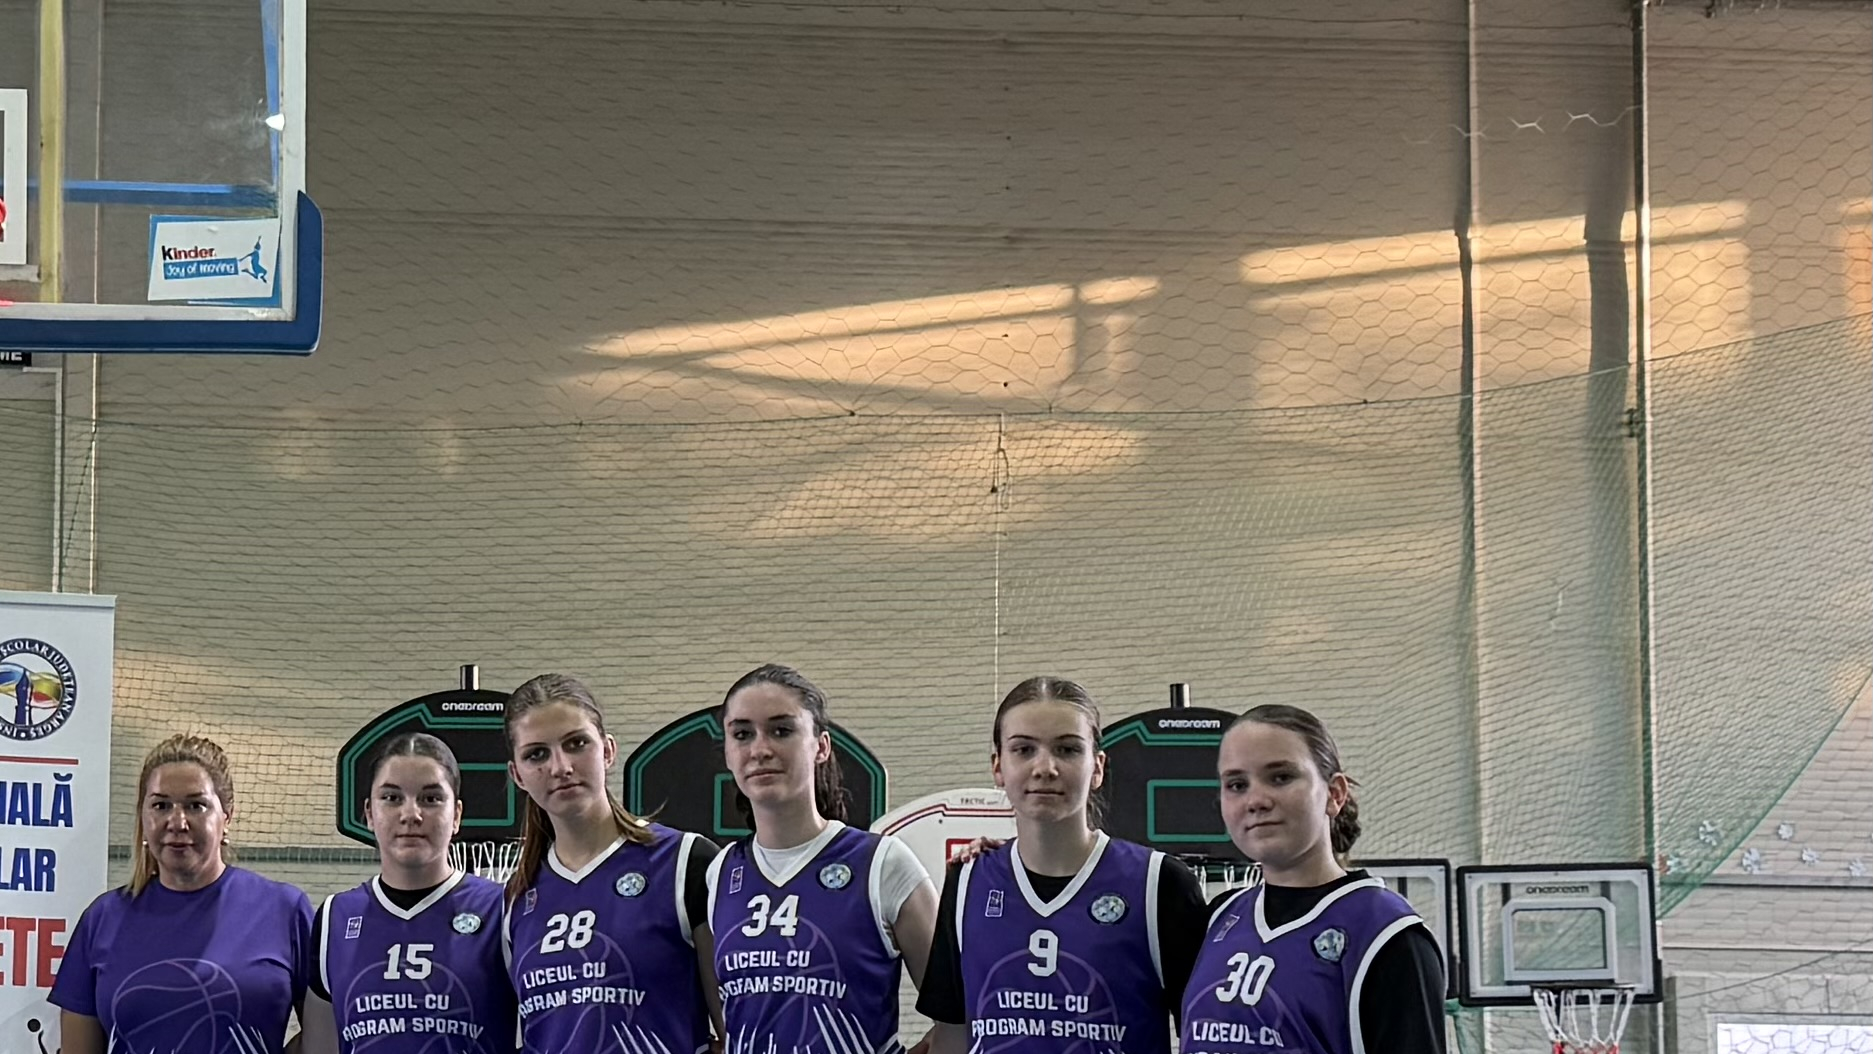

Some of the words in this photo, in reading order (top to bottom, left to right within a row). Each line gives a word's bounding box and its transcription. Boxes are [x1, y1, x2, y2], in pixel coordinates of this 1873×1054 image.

[187, 263, 197, 274] of
[741, 894, 800, 938] 34
[539, 909, 597, 955] 28
[383, 943, 434, 981] 15
[724, 950, 781, 972] LICEUL
[786, 950, 811, 968] CU
[1027, 928, 1059, 977] 9
[522, 964, 578, 989] LICEUL
[582, 961, 606, 979] CU
[771, 975, 847, 999] SPORTIV
[1215, 951, 1276, 1006] 30
[355, 993, 418, 1013] LICEUL
[424, 994, 450, 1010] CU
[571, 986, 646, 1006] SPORTIV
[997, 991, 1059, 1011] LICEUL
[1064, 994, 1089, 1013] CU
[412, 1017, 484, 1040] SPORTIV
[971, 1018, 1046, 1038] PROGRAM
[1051, 1019, 1127, 1042] SPORTIV
[1191, 1021, 1256, 1045] LICEUL
